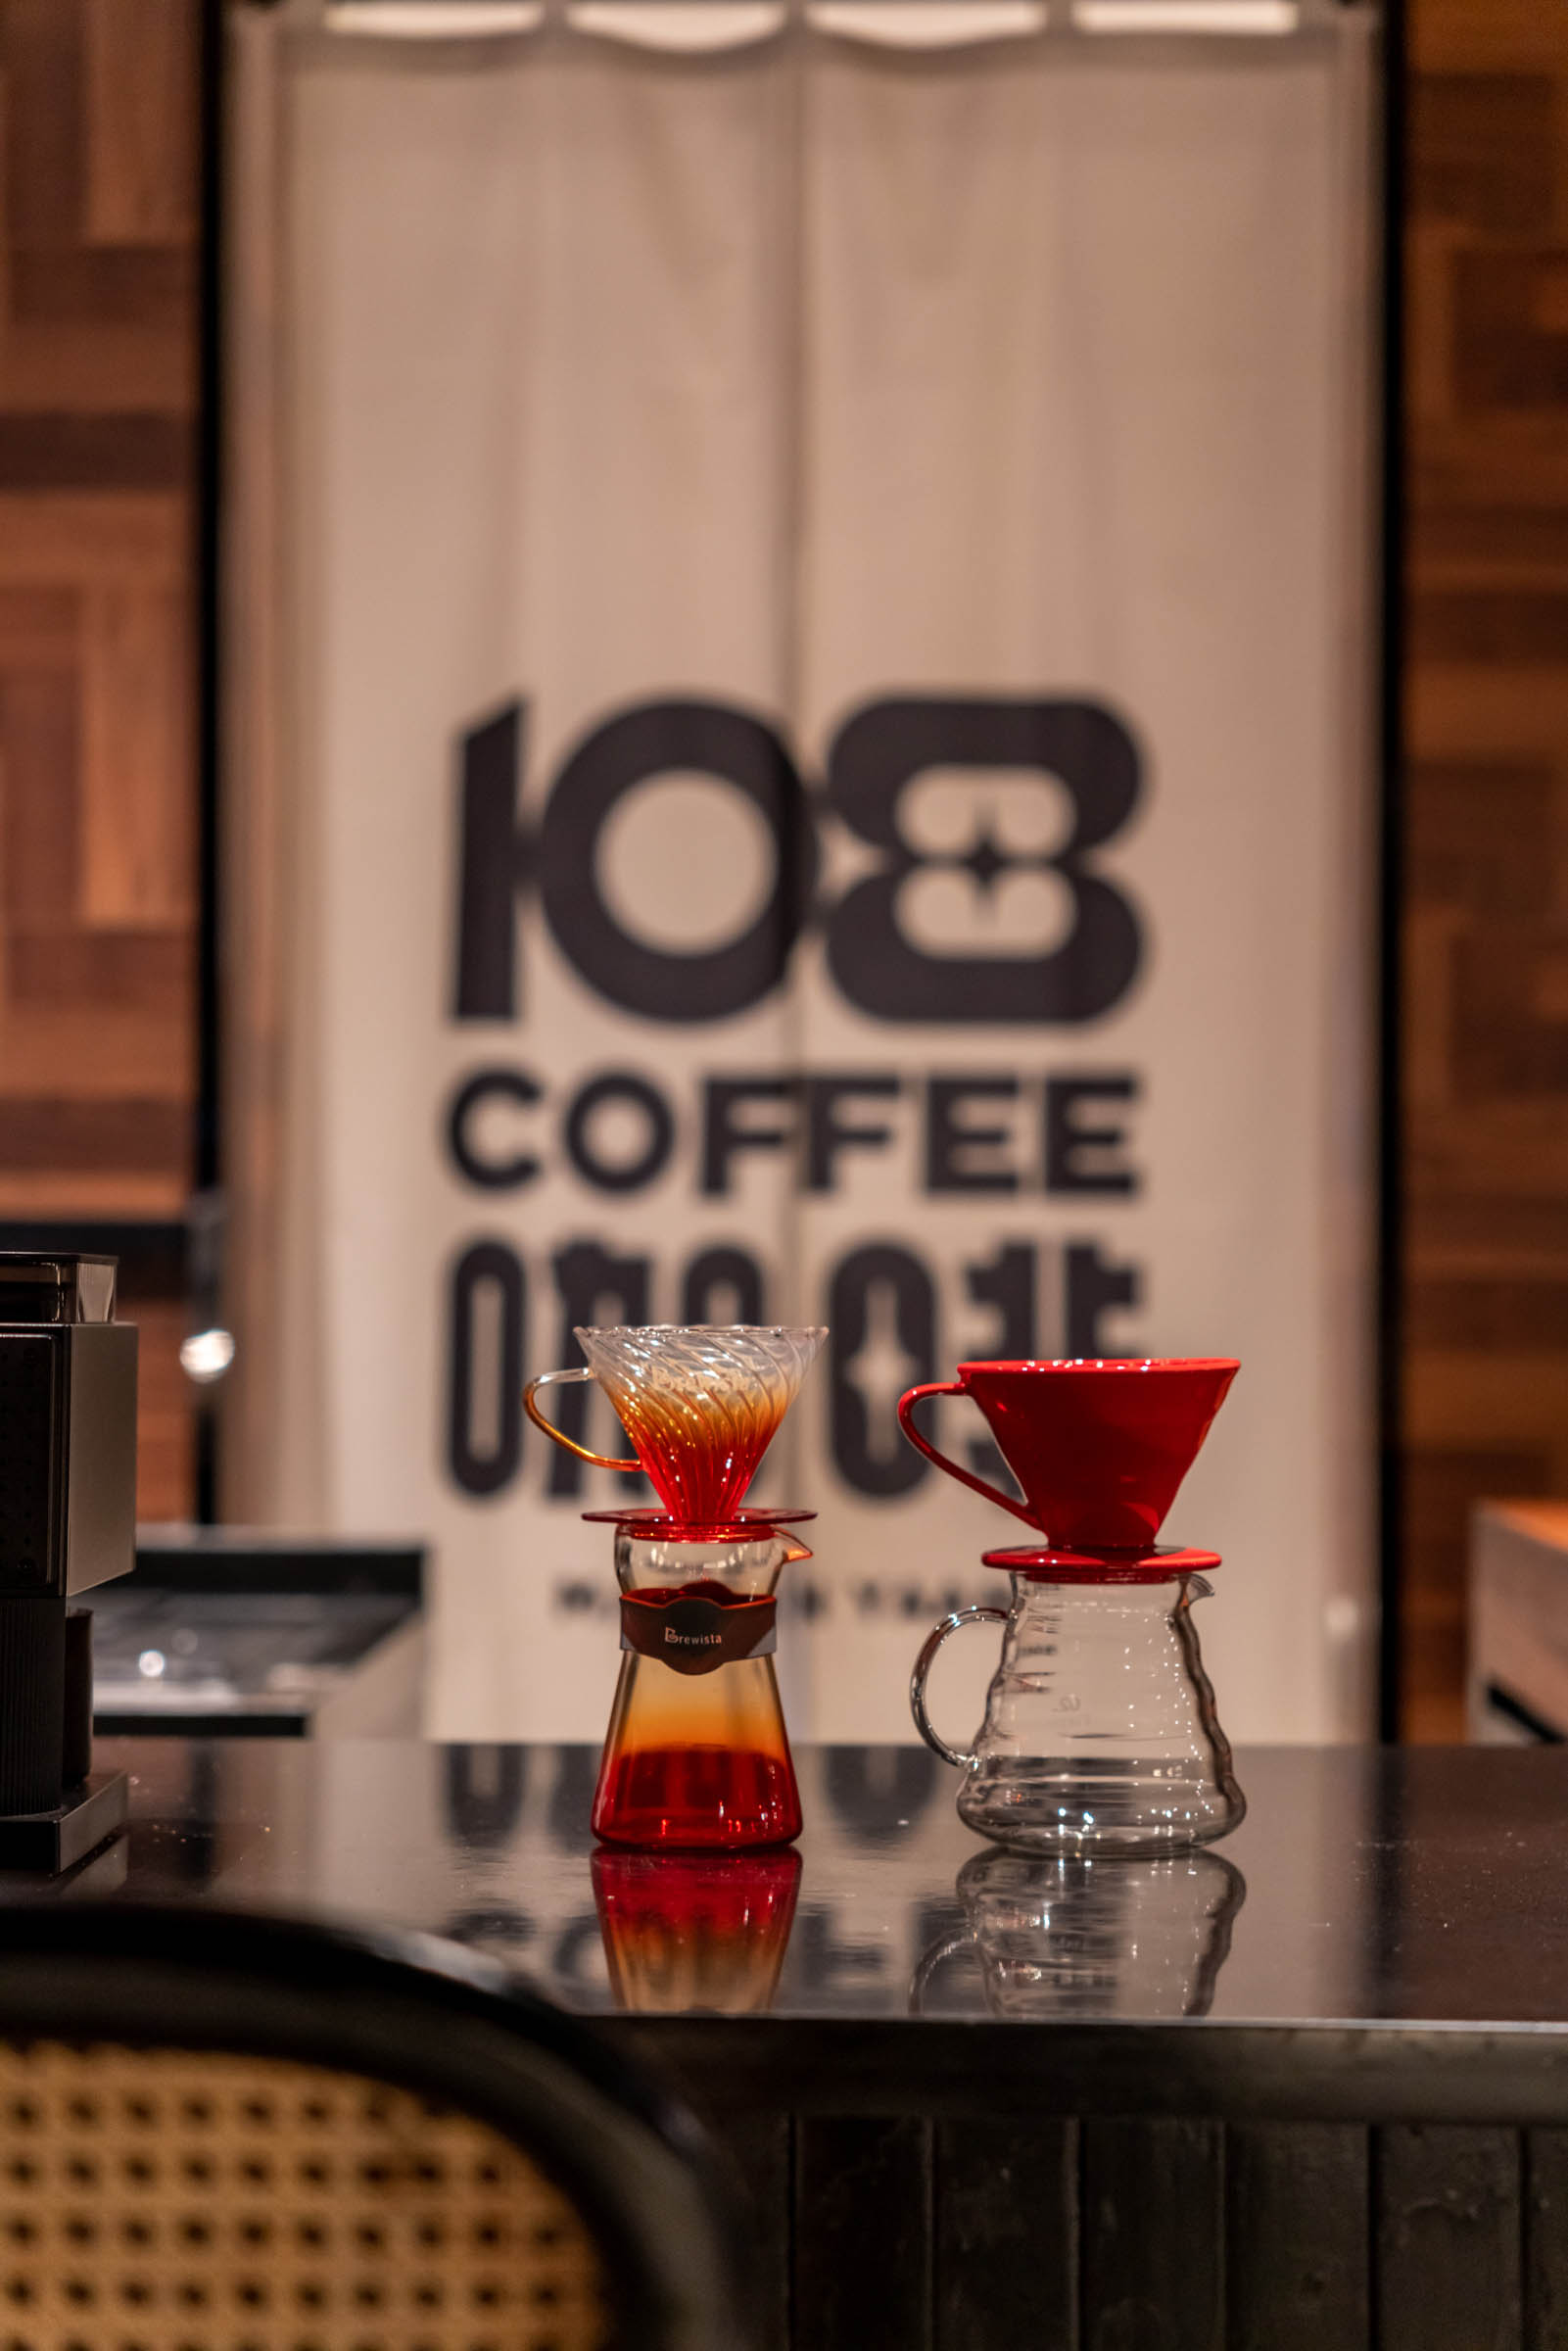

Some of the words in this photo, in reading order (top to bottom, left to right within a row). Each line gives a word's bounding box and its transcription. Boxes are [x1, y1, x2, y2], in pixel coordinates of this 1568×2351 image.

[449, 692, 1149, 1031] 108
[442, 1065, 1141, 1200] COFFEE
[664, 1626, 722, 1645] Brewista
